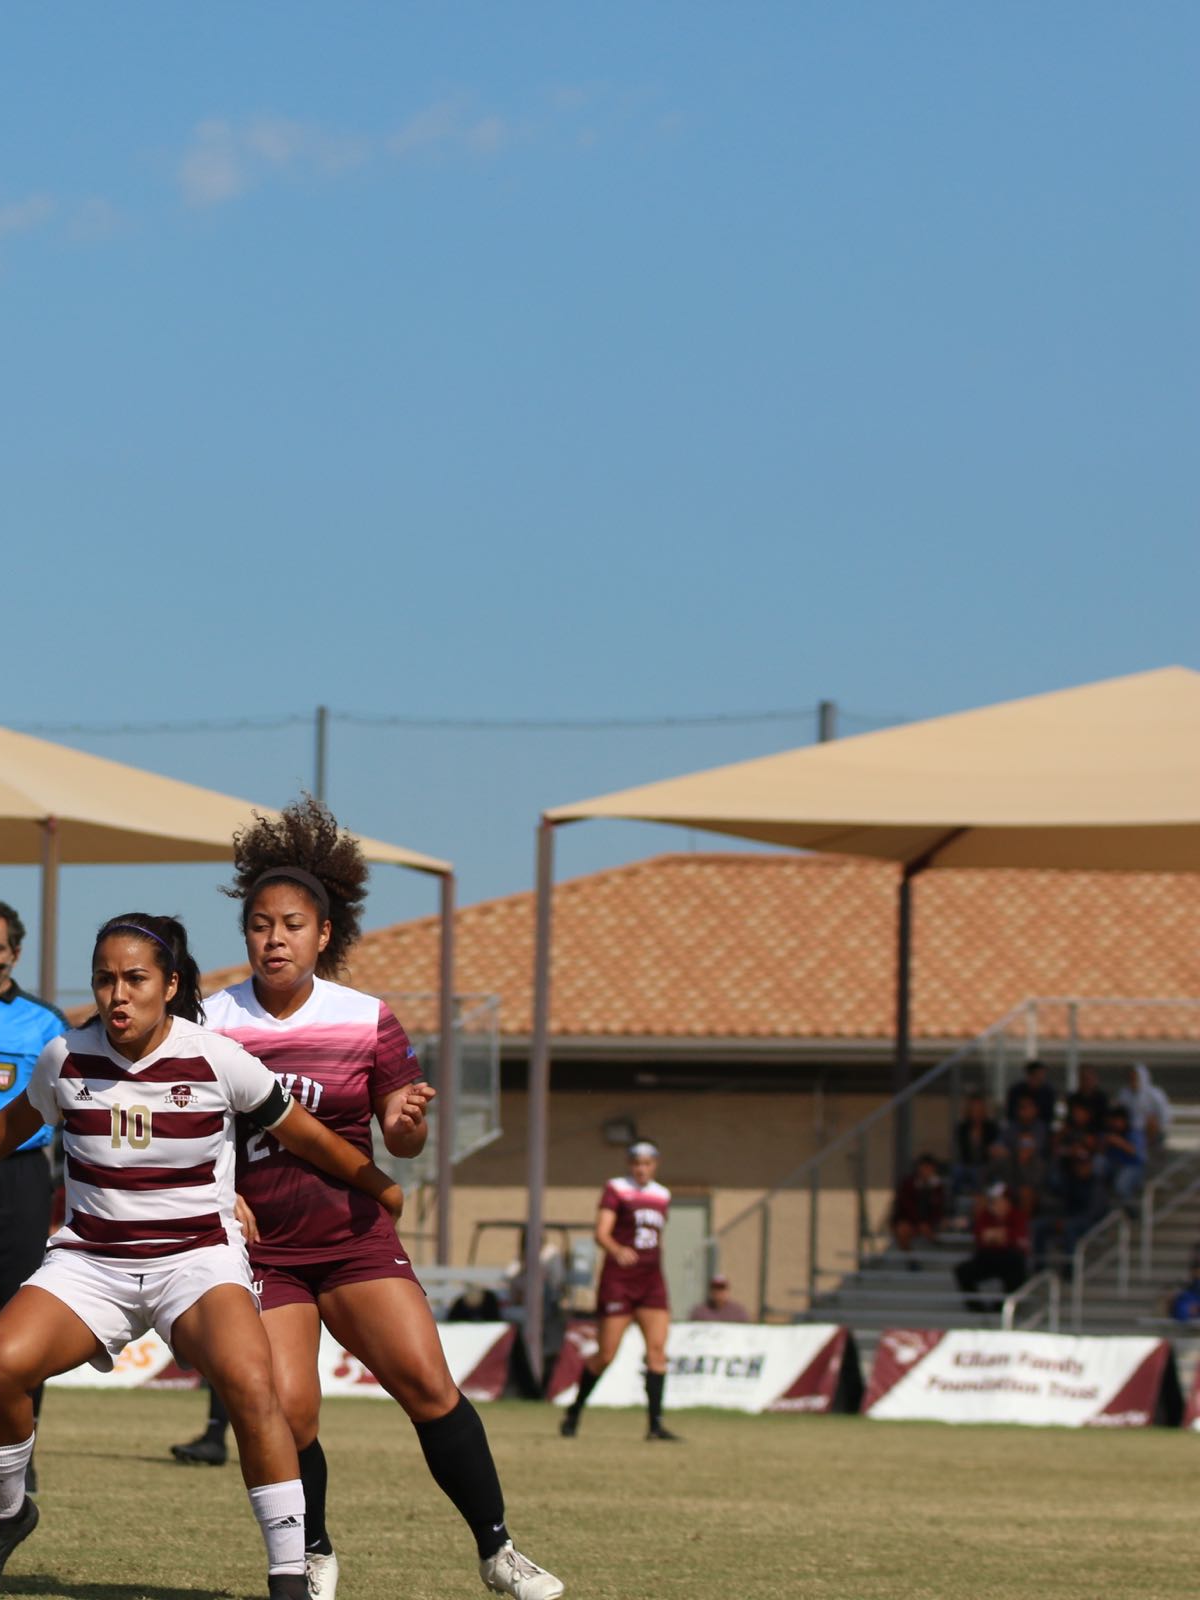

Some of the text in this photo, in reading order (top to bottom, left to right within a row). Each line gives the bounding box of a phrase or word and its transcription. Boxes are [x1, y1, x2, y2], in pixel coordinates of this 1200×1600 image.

[111, 1103, 151, 1150] 10
[1018, 1354, 1085, 1377] Family
[925, 1375, 1100, 1401] Foundation Trust
